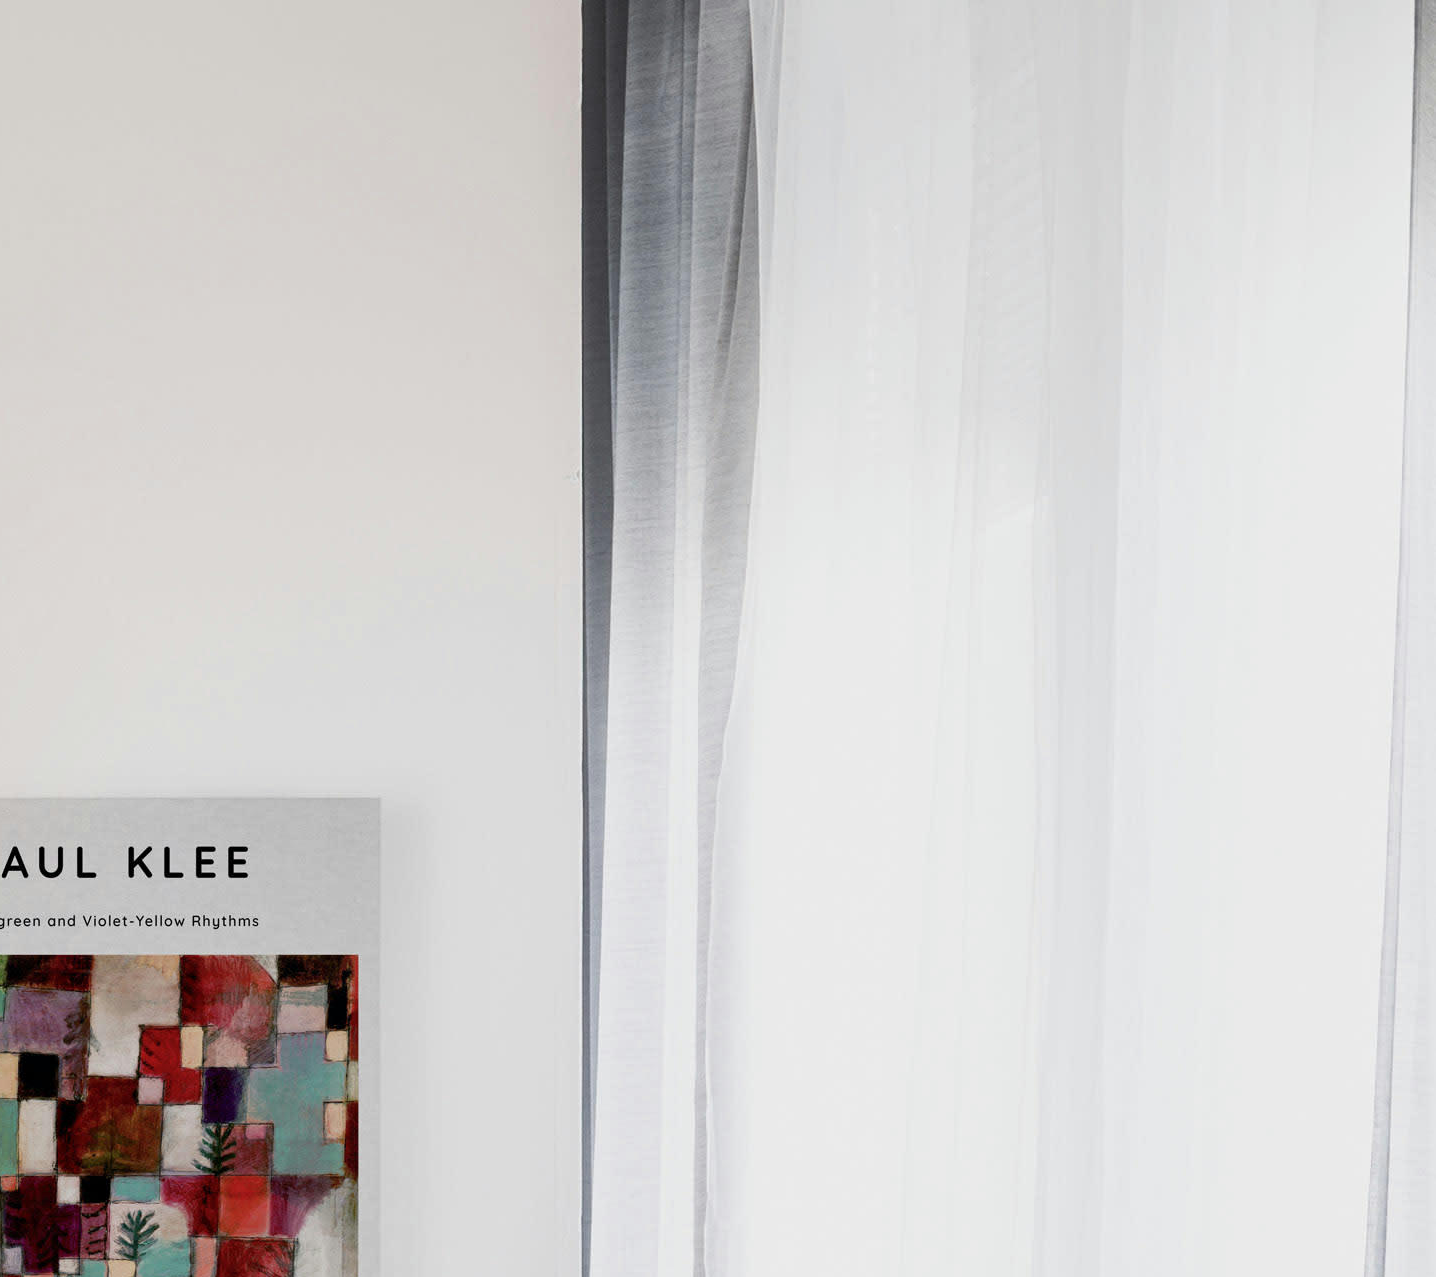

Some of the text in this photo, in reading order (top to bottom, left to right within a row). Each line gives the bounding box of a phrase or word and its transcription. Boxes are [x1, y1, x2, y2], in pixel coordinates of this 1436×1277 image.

[127, 845, 249, 879] KLEE
[47, 914, 76, 928] and
[82, 914, 186, 928] Violet-Yellow
[191, 914, 259, 930] Rhythms
